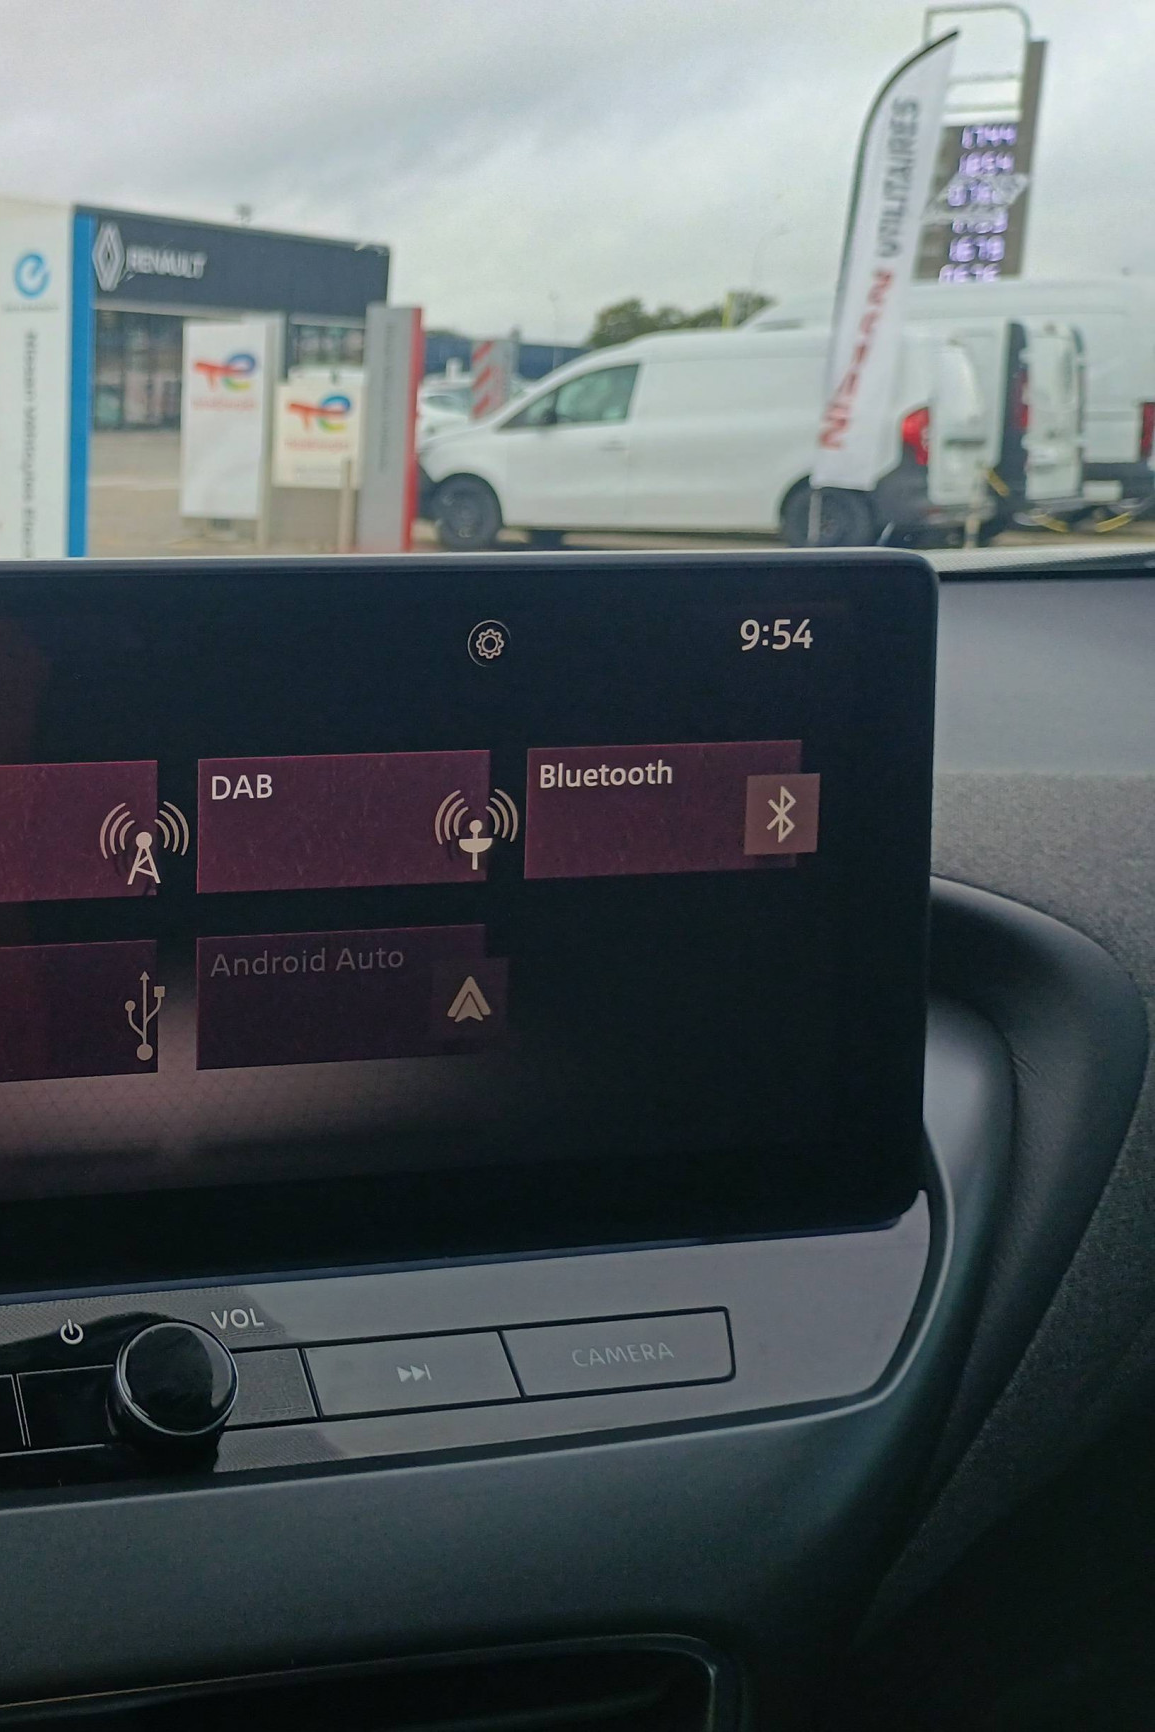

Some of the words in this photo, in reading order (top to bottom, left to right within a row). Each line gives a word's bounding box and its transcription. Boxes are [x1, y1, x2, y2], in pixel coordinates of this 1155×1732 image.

[126, 246, 207, 279] RENAULT
[740, 618, 814, 651] 9:54
[211, 773, 273, 800] DAB
[539, 759, 673, 789] Bluetooth
[210, 946, 326, 978] Android
[335, 947, 404, 971] Auto
[210, 1308, 265, 1330] VOL
[571, 1341, 675, 1368] CAMERA
